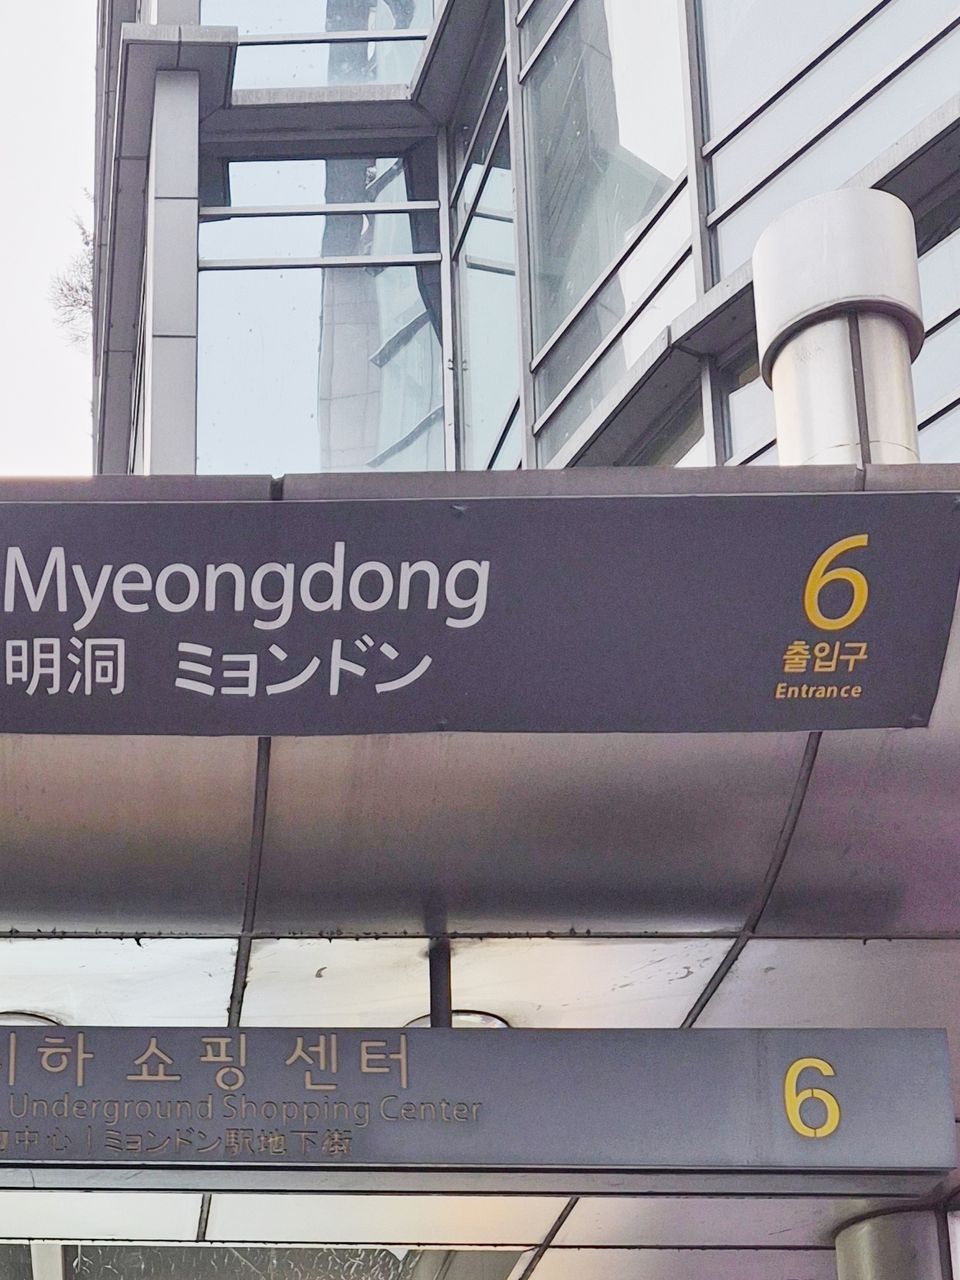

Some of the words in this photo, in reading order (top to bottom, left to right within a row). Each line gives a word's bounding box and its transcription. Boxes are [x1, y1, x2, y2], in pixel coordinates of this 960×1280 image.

[3, 541, 491, 632] Myeongdong
[804, 534, 869, 630] 6
[5, 636, 126, 696] 明洞
[174, 633, 434, 697] ミョンドン
[783, 640, 868, 673] 출입구
[775, 683, 862, 699] Entrance
[9, 1092, 213, 1125] Underground
[222, 1093, 369, 1127] Shopping
[380, 1094, 482, 1122] Center
[784, 1057, 841, 1138] 6
